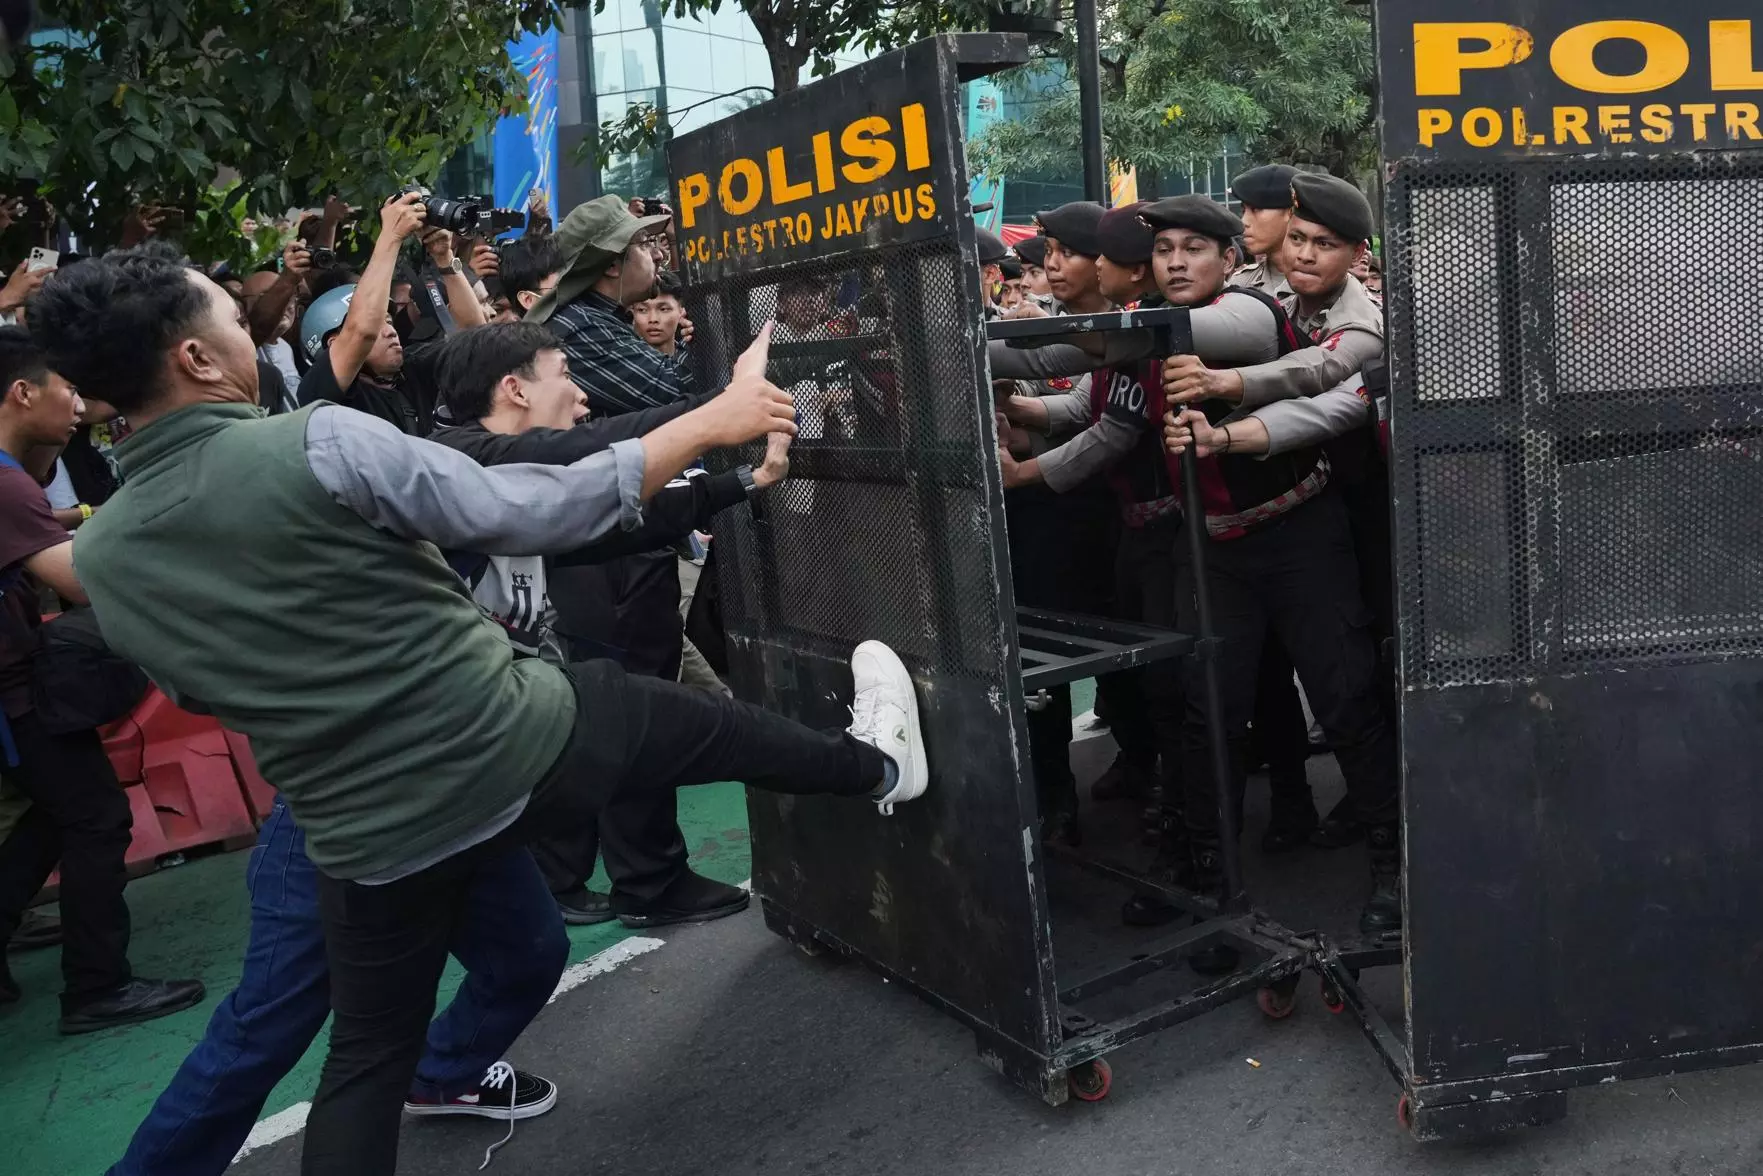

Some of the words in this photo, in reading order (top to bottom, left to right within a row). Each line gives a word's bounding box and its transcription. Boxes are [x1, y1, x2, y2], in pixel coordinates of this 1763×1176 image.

[1413, 20, 1763, 96] POL
[1418, 103, 1763, 148] POLRESTR
[678, 103, 930, 229] POLISI
[686, 212, 813, 263] POESTRO
[820, 184, 936, 240] JAKPUS
[1107, 371, 1149, 420] IRO
